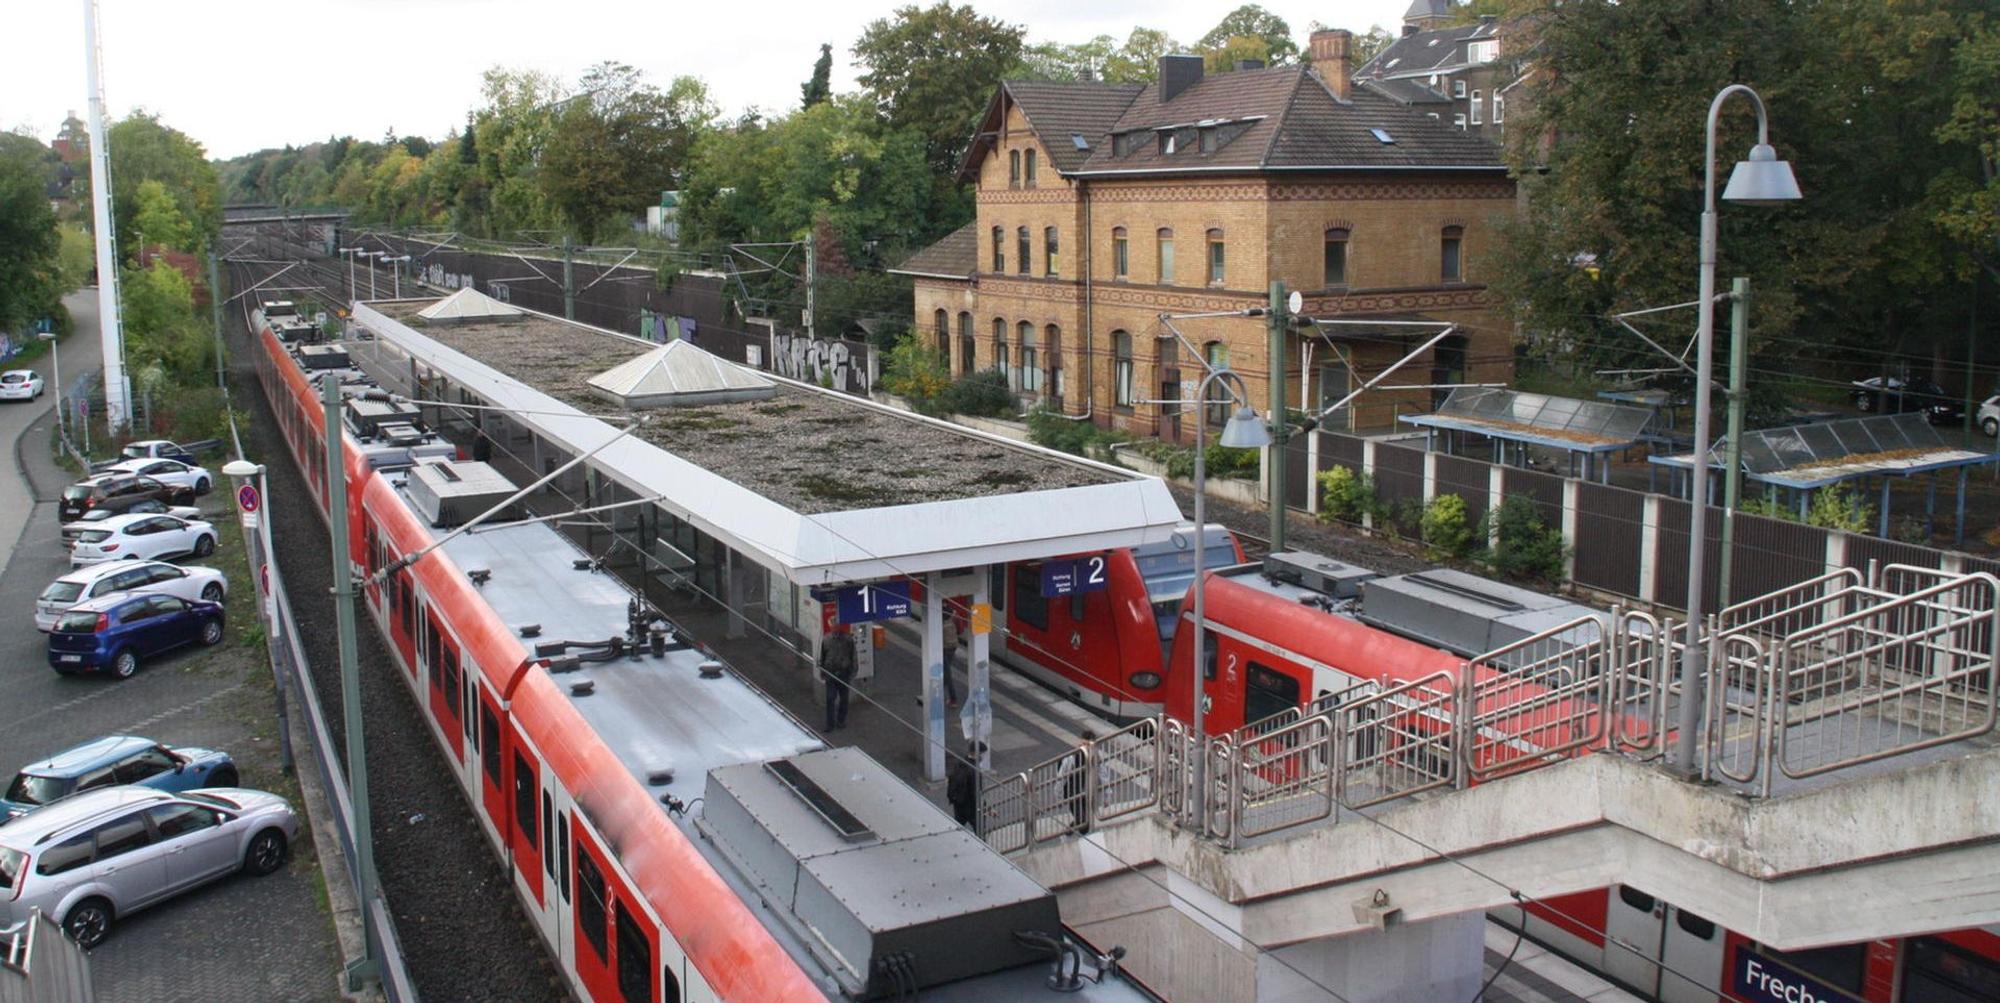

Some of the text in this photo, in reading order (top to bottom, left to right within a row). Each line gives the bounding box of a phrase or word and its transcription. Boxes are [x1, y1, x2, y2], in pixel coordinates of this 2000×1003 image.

[1088, 556, 1105, 584] 2
[858, 585, 869, 613] 1
[1228, 654, 1237, 674] 2
[608, 885, 615, 914] 2
[1746, 959, 1827, 1003] Frech
